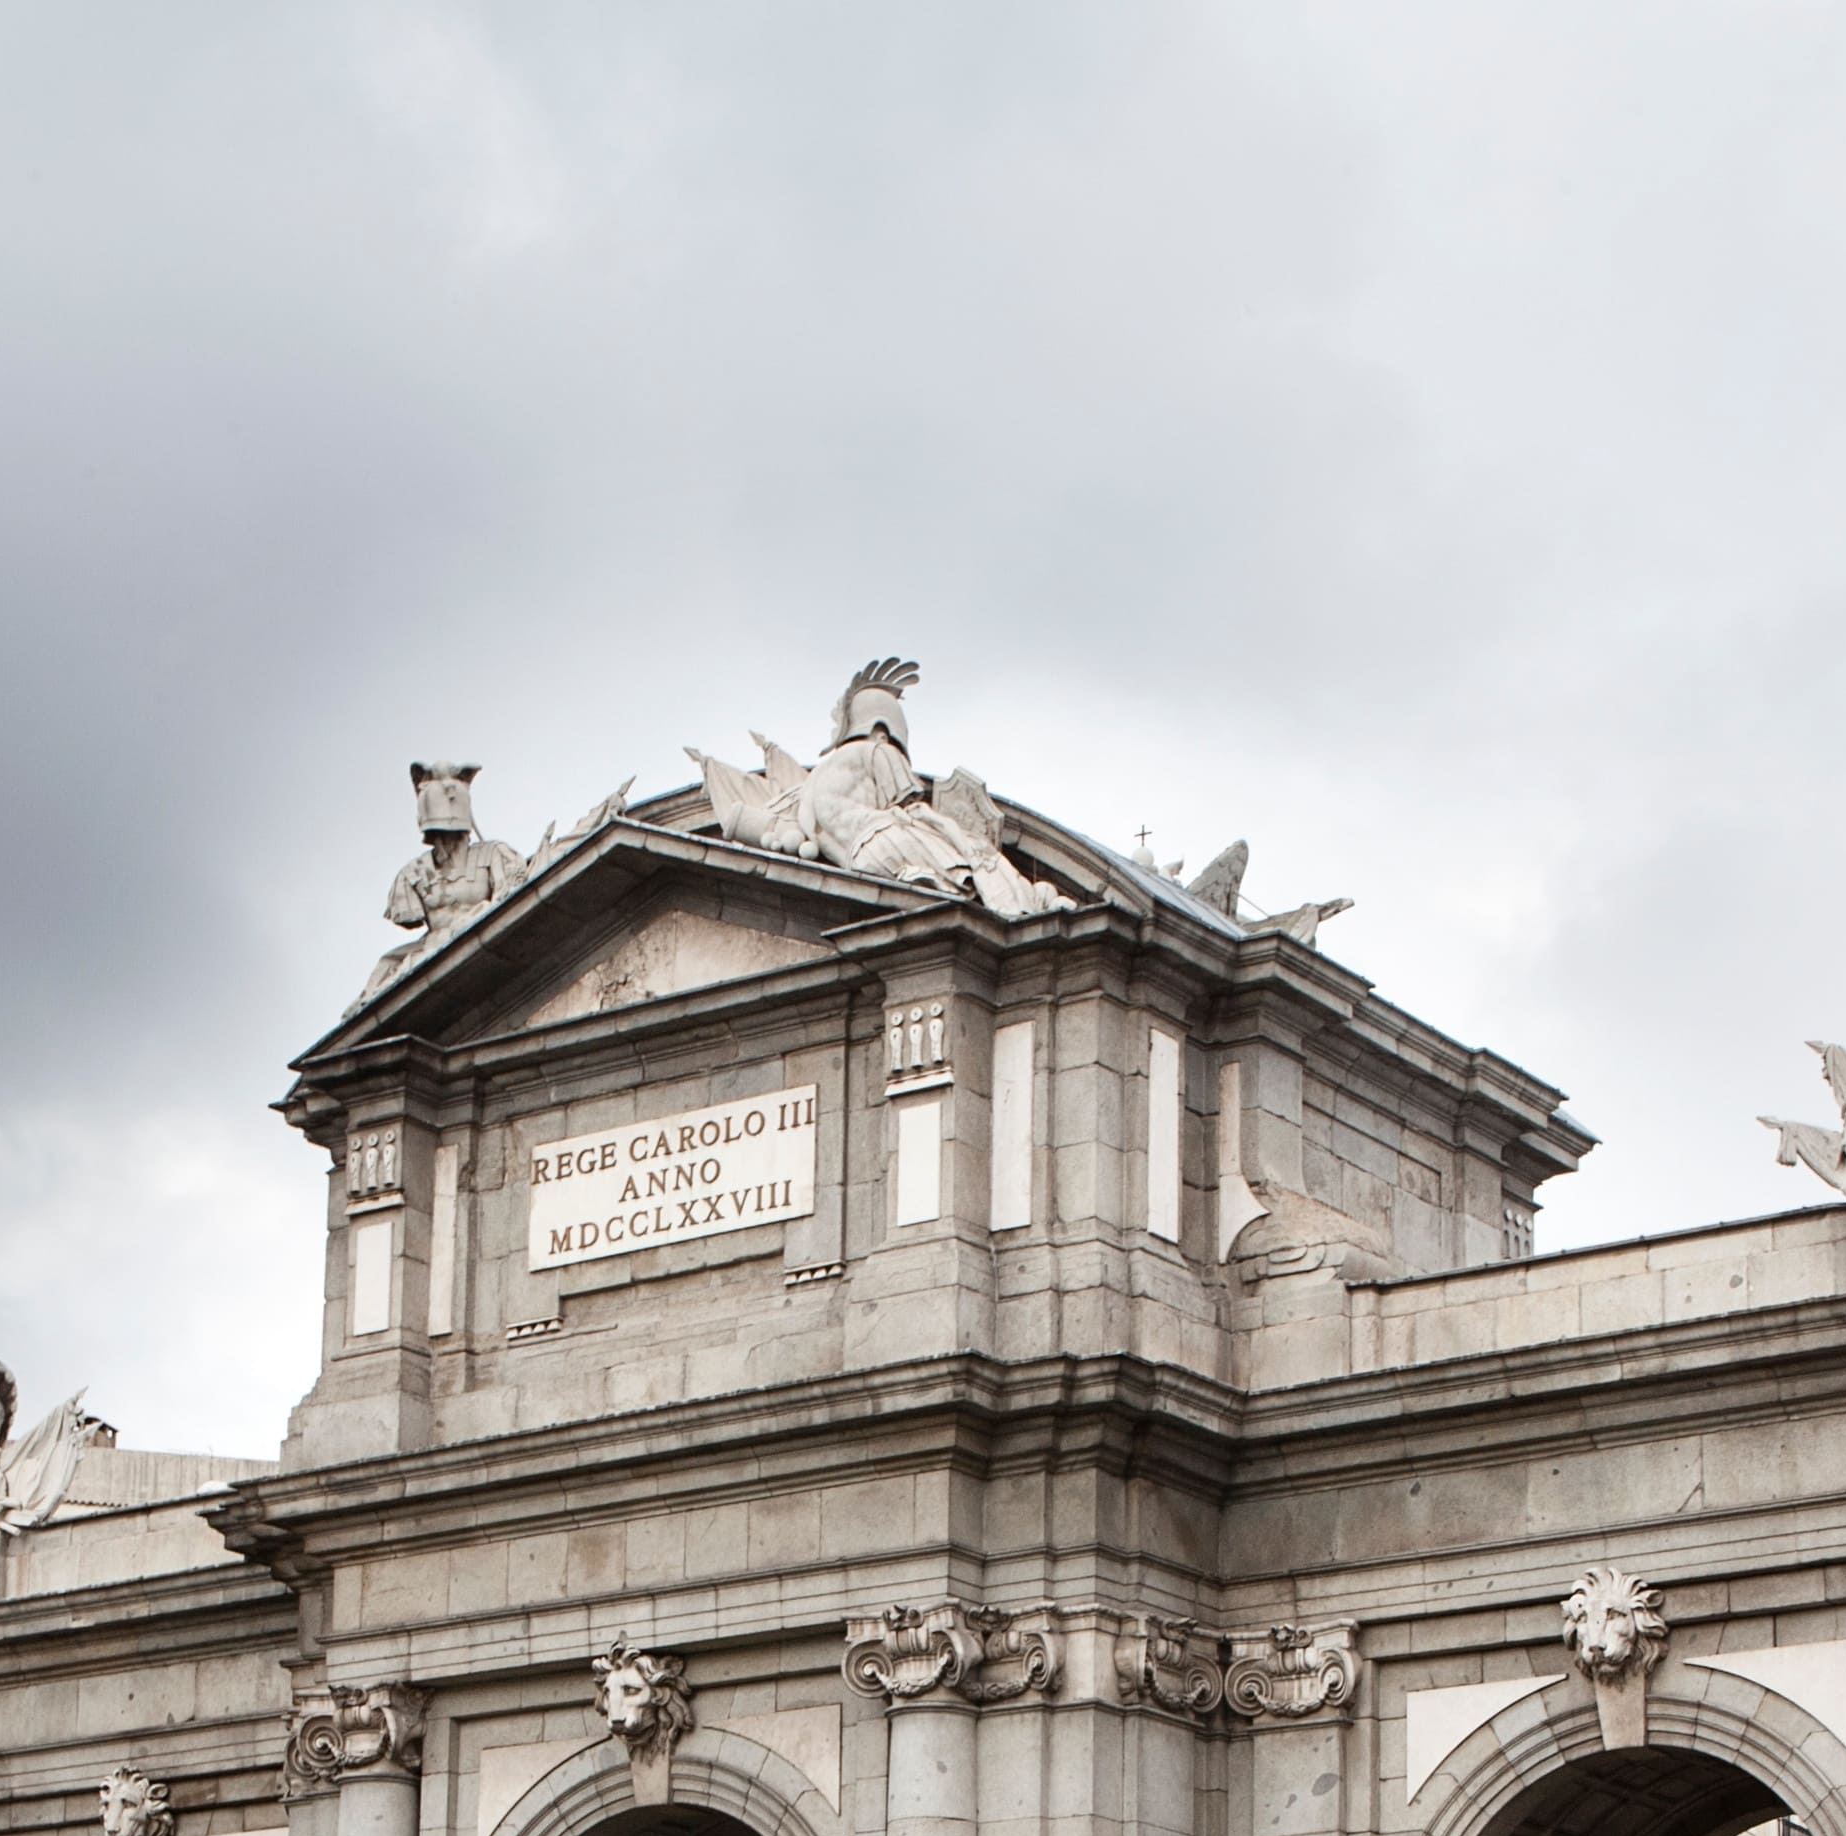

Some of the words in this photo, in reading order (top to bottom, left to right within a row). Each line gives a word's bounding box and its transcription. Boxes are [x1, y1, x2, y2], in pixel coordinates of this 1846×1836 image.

[531, 1142, 617, 1186] REGE
[629, 1110, 766, 1161] CAROLO
[778, 1098, 816, 1132] III
[548, 1179, 793, 1255] MDCCLXXVIII
[619, 1158, 721, 1203] ANNO
